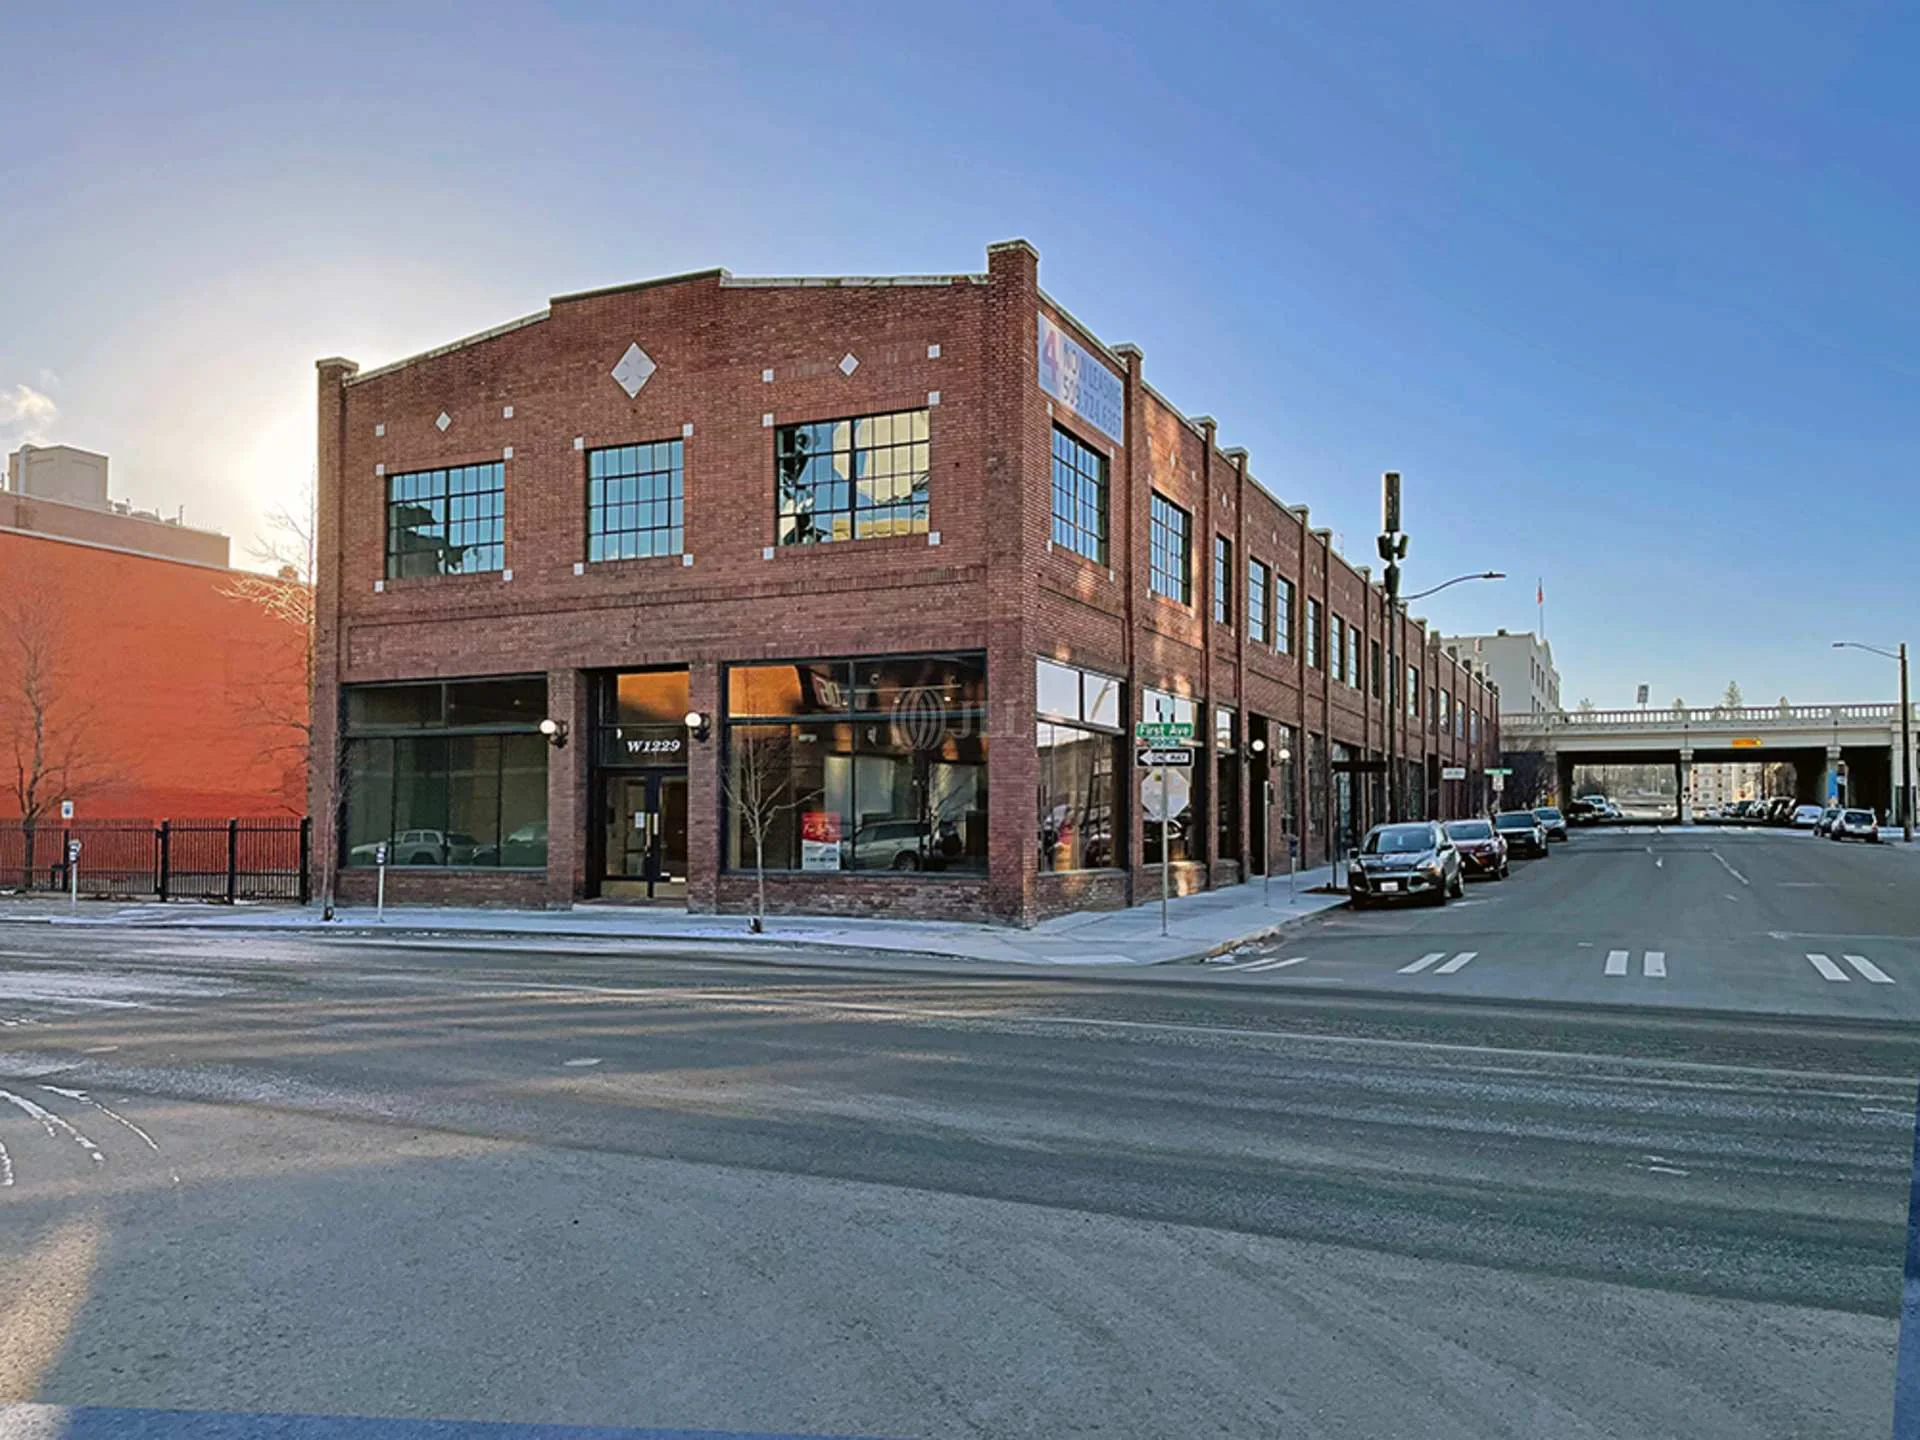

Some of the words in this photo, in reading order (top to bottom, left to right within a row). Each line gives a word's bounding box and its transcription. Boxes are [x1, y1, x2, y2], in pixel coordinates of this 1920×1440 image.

[1043, 329, 1058, 383] 4
[1169, 724, 1190, 736] Ave
[627, 740, 681, 753] W1229
